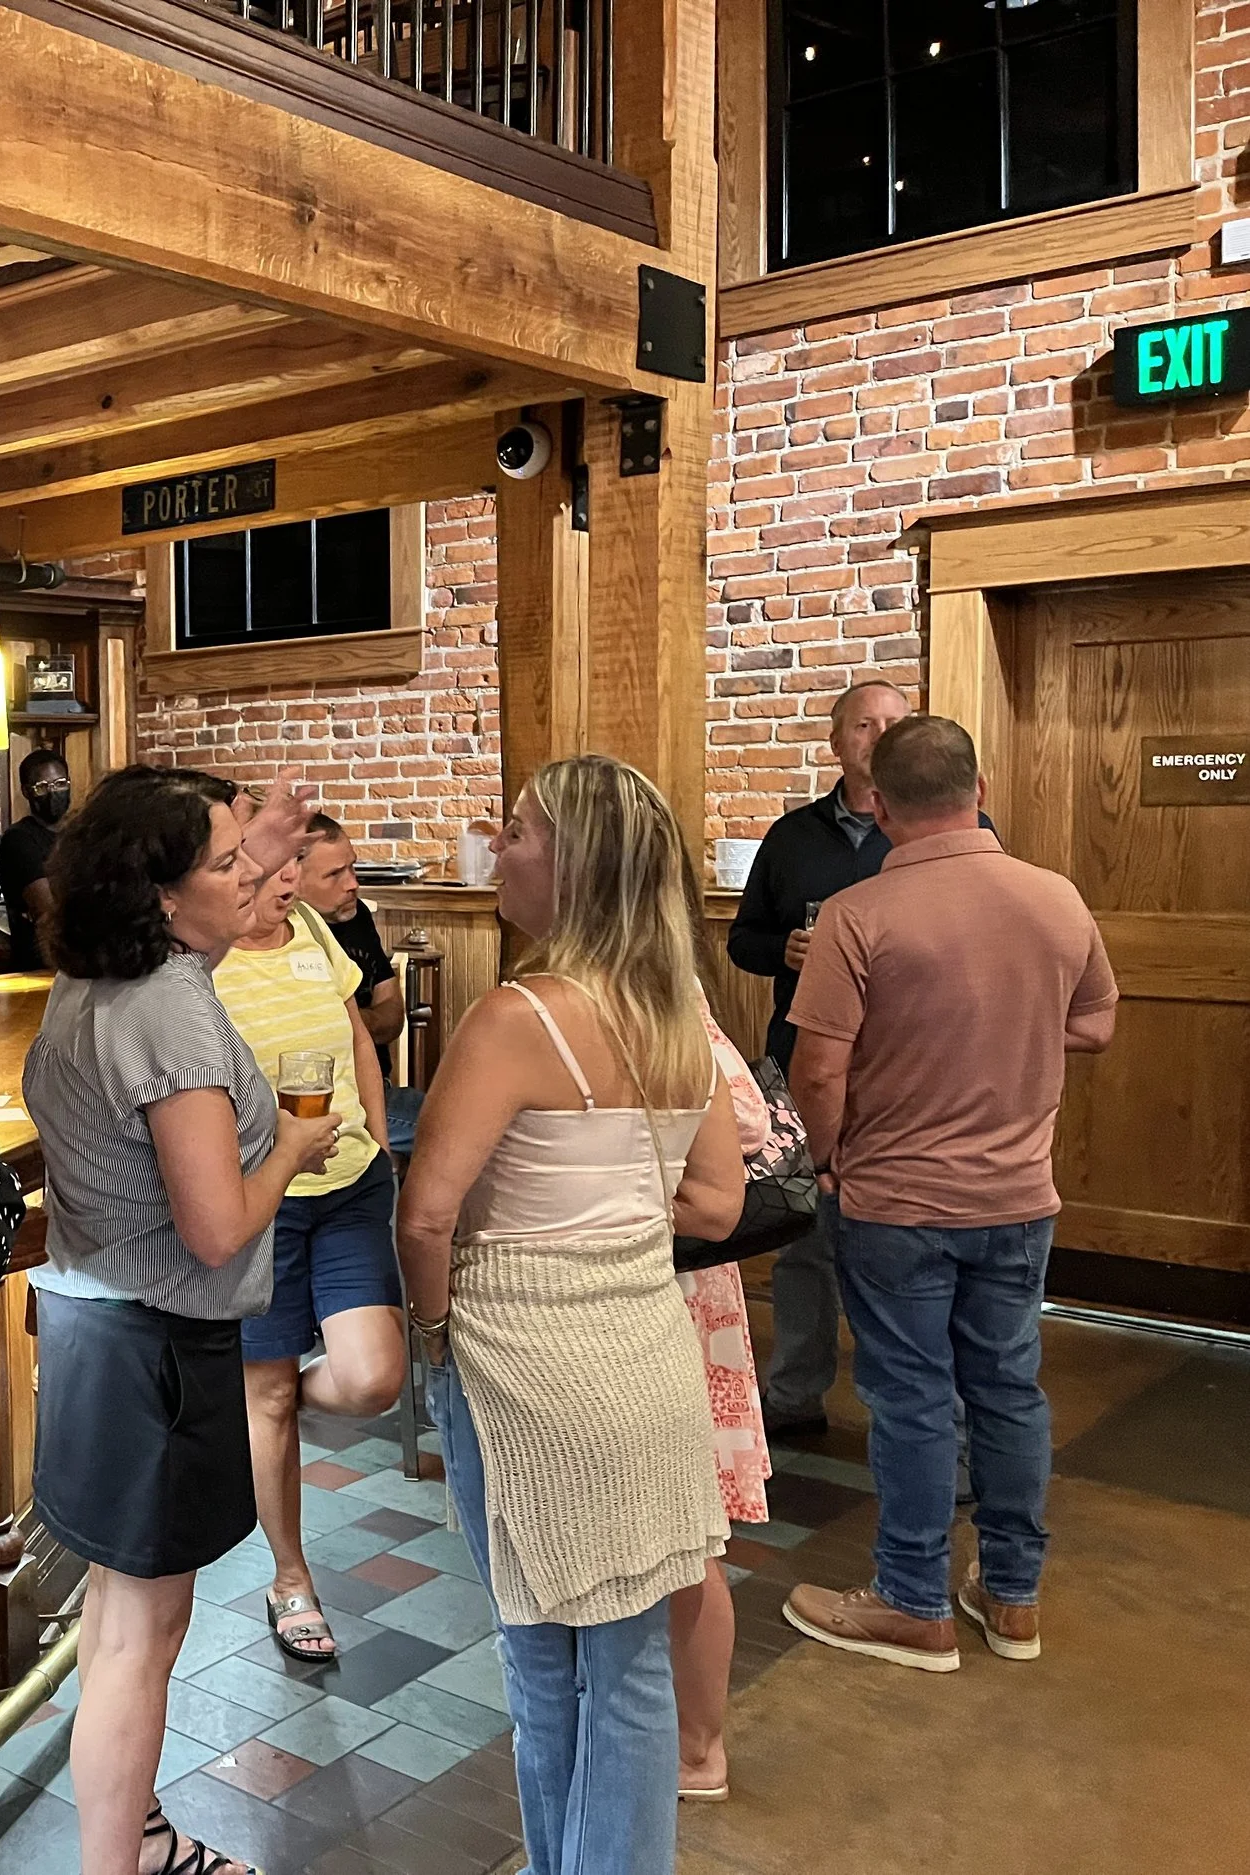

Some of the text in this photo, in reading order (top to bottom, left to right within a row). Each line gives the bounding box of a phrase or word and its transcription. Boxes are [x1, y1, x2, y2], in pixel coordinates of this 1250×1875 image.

[1138, 320, 1229, 394] EXIT
[143, 474, 238, 525] PORTER
[253, 478, 270, 498] ST
[1152, 753, 1246, 781] EMERGENCY ONLY
